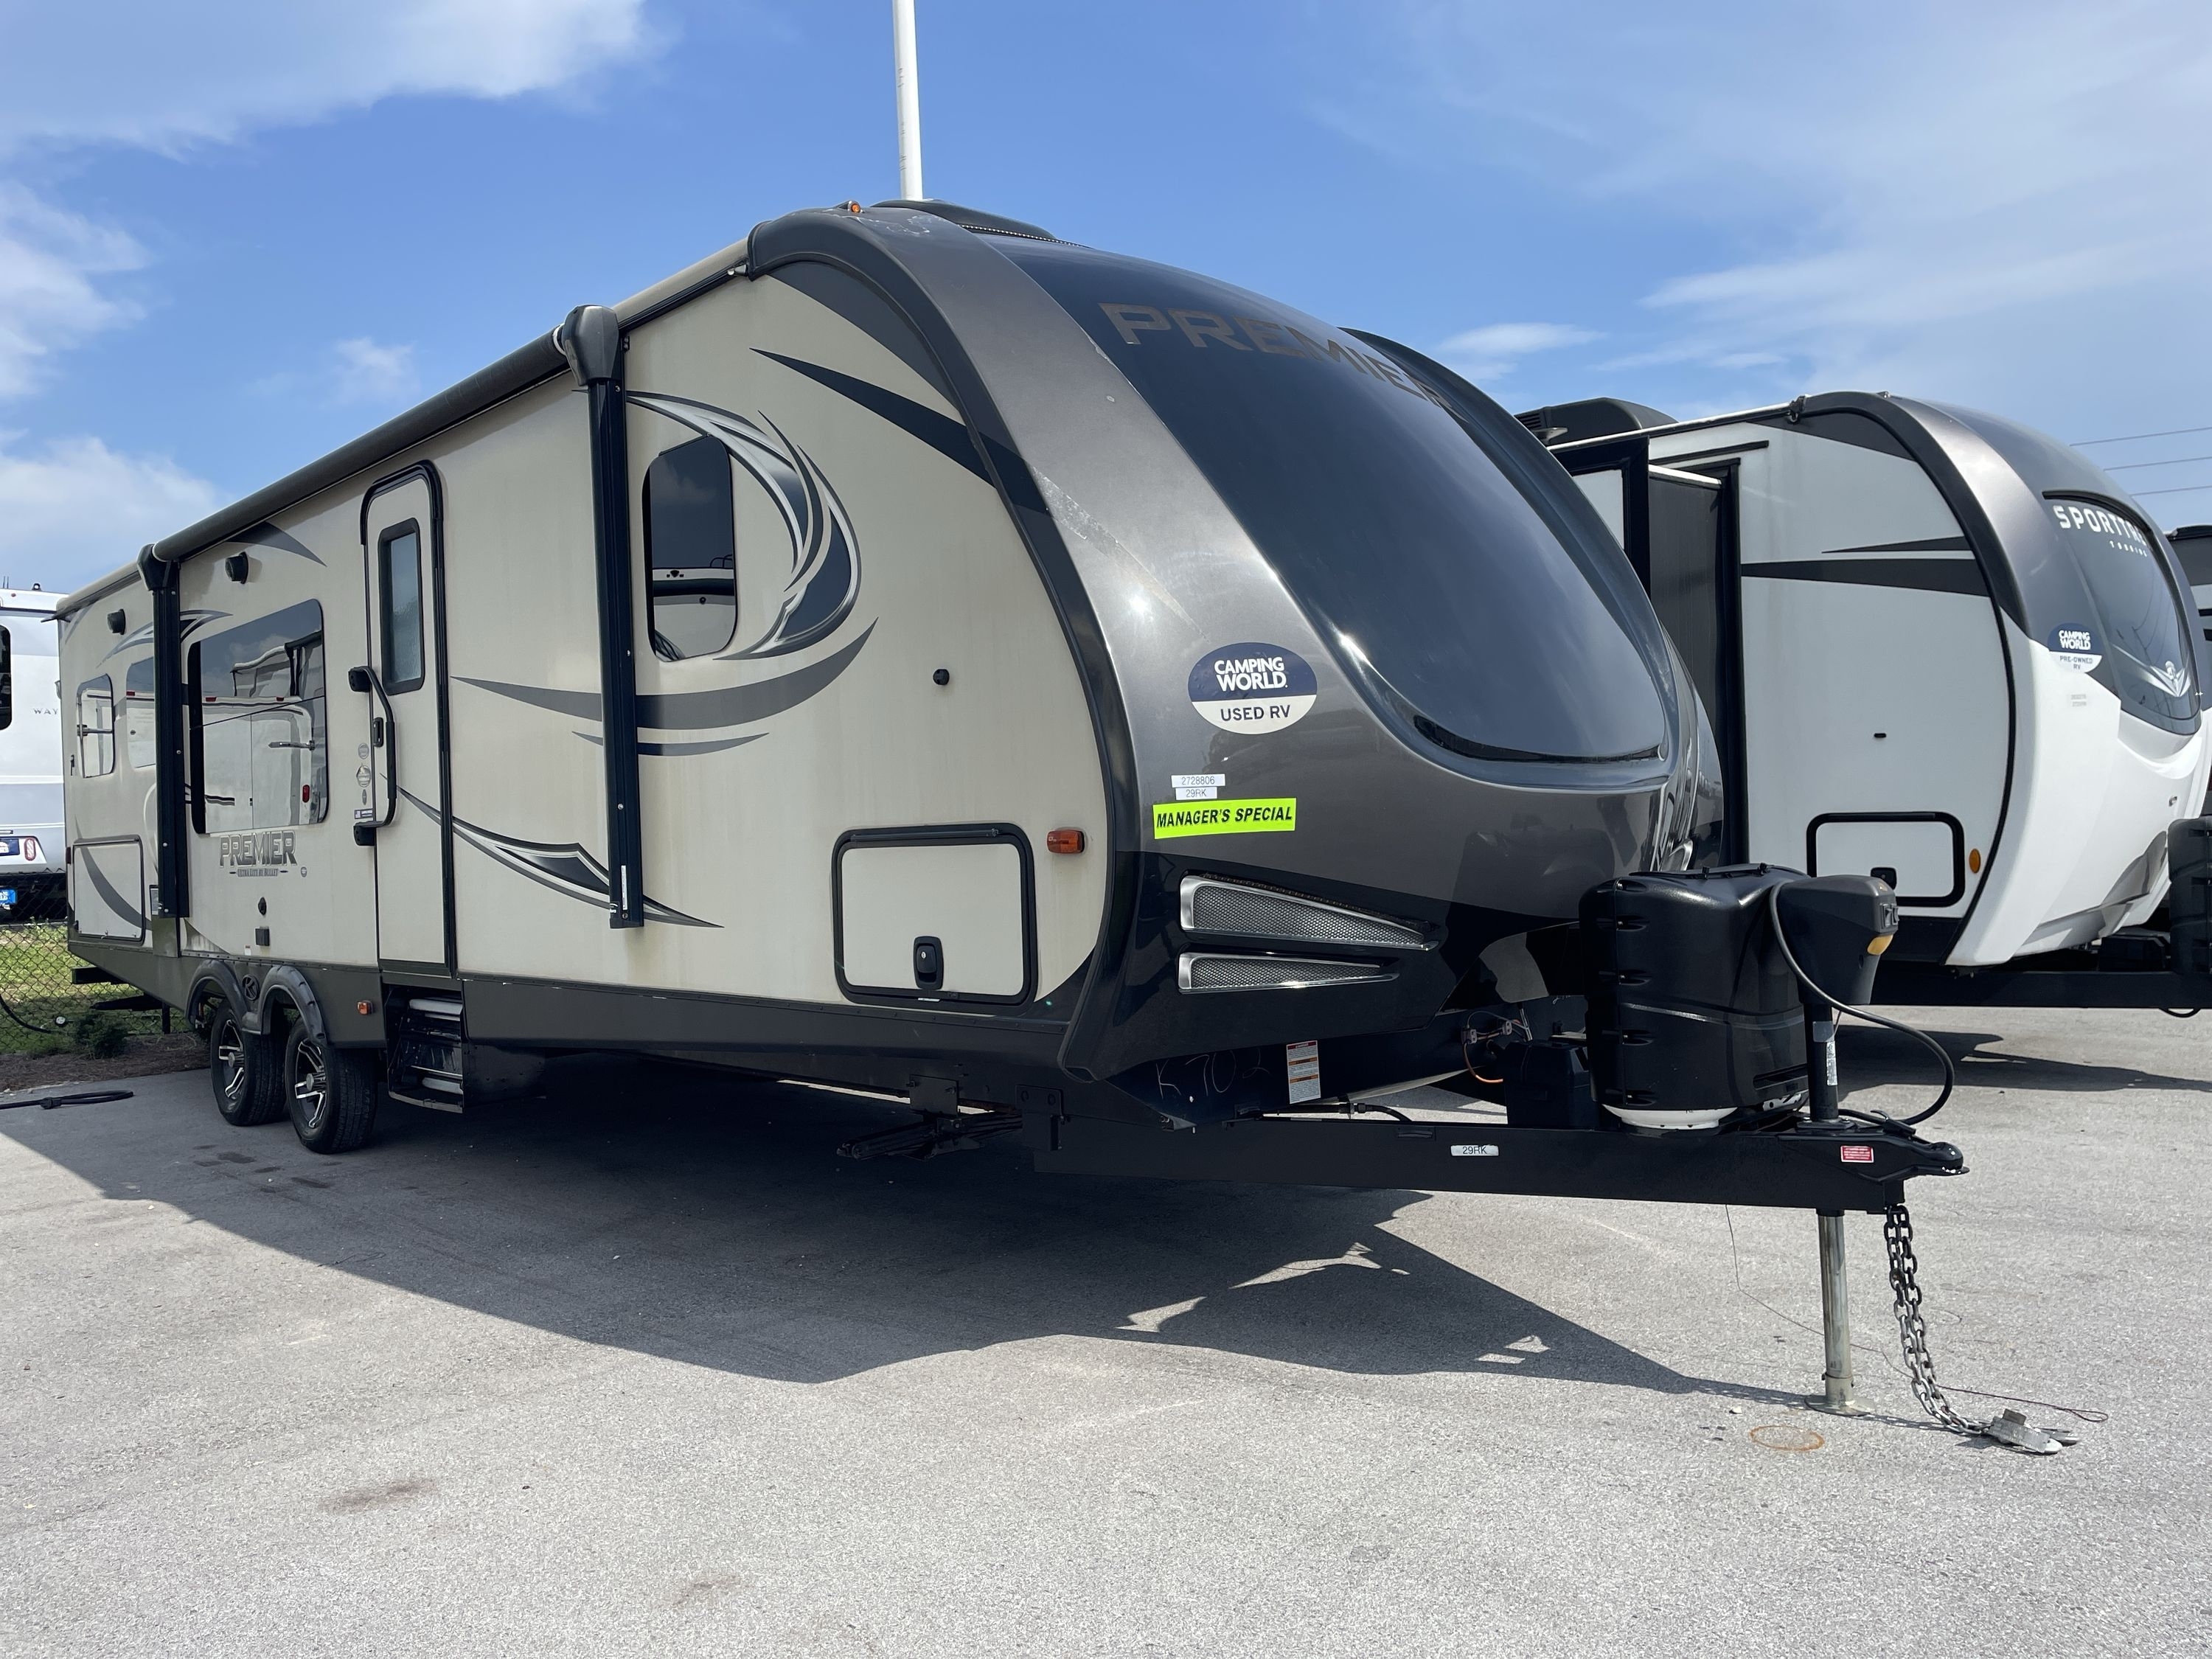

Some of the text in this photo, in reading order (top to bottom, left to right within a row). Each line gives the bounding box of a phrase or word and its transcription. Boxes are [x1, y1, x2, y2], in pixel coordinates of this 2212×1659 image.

[1098, 302, 1470, 424] PREMIER
[2059, 630, 2090, 641] CAMPING
[2059, 638, 2091, 650] WORLD
[2059, 655, 2093, 664] PRE-OWNED
[1214, 657, 1285, 675] CAMPING
[1220, 704, 1291, 722] USED RV
[1181, 776, 1215, 786] 2728806
[1186, 788, 1207, 798] 29RK
[1156, 807, 1293, 828] MANAGER'S SPECIAL
[220, 830, 298, 868] PREMIER
[1463, 1146, 1487, 1155] 29RK
